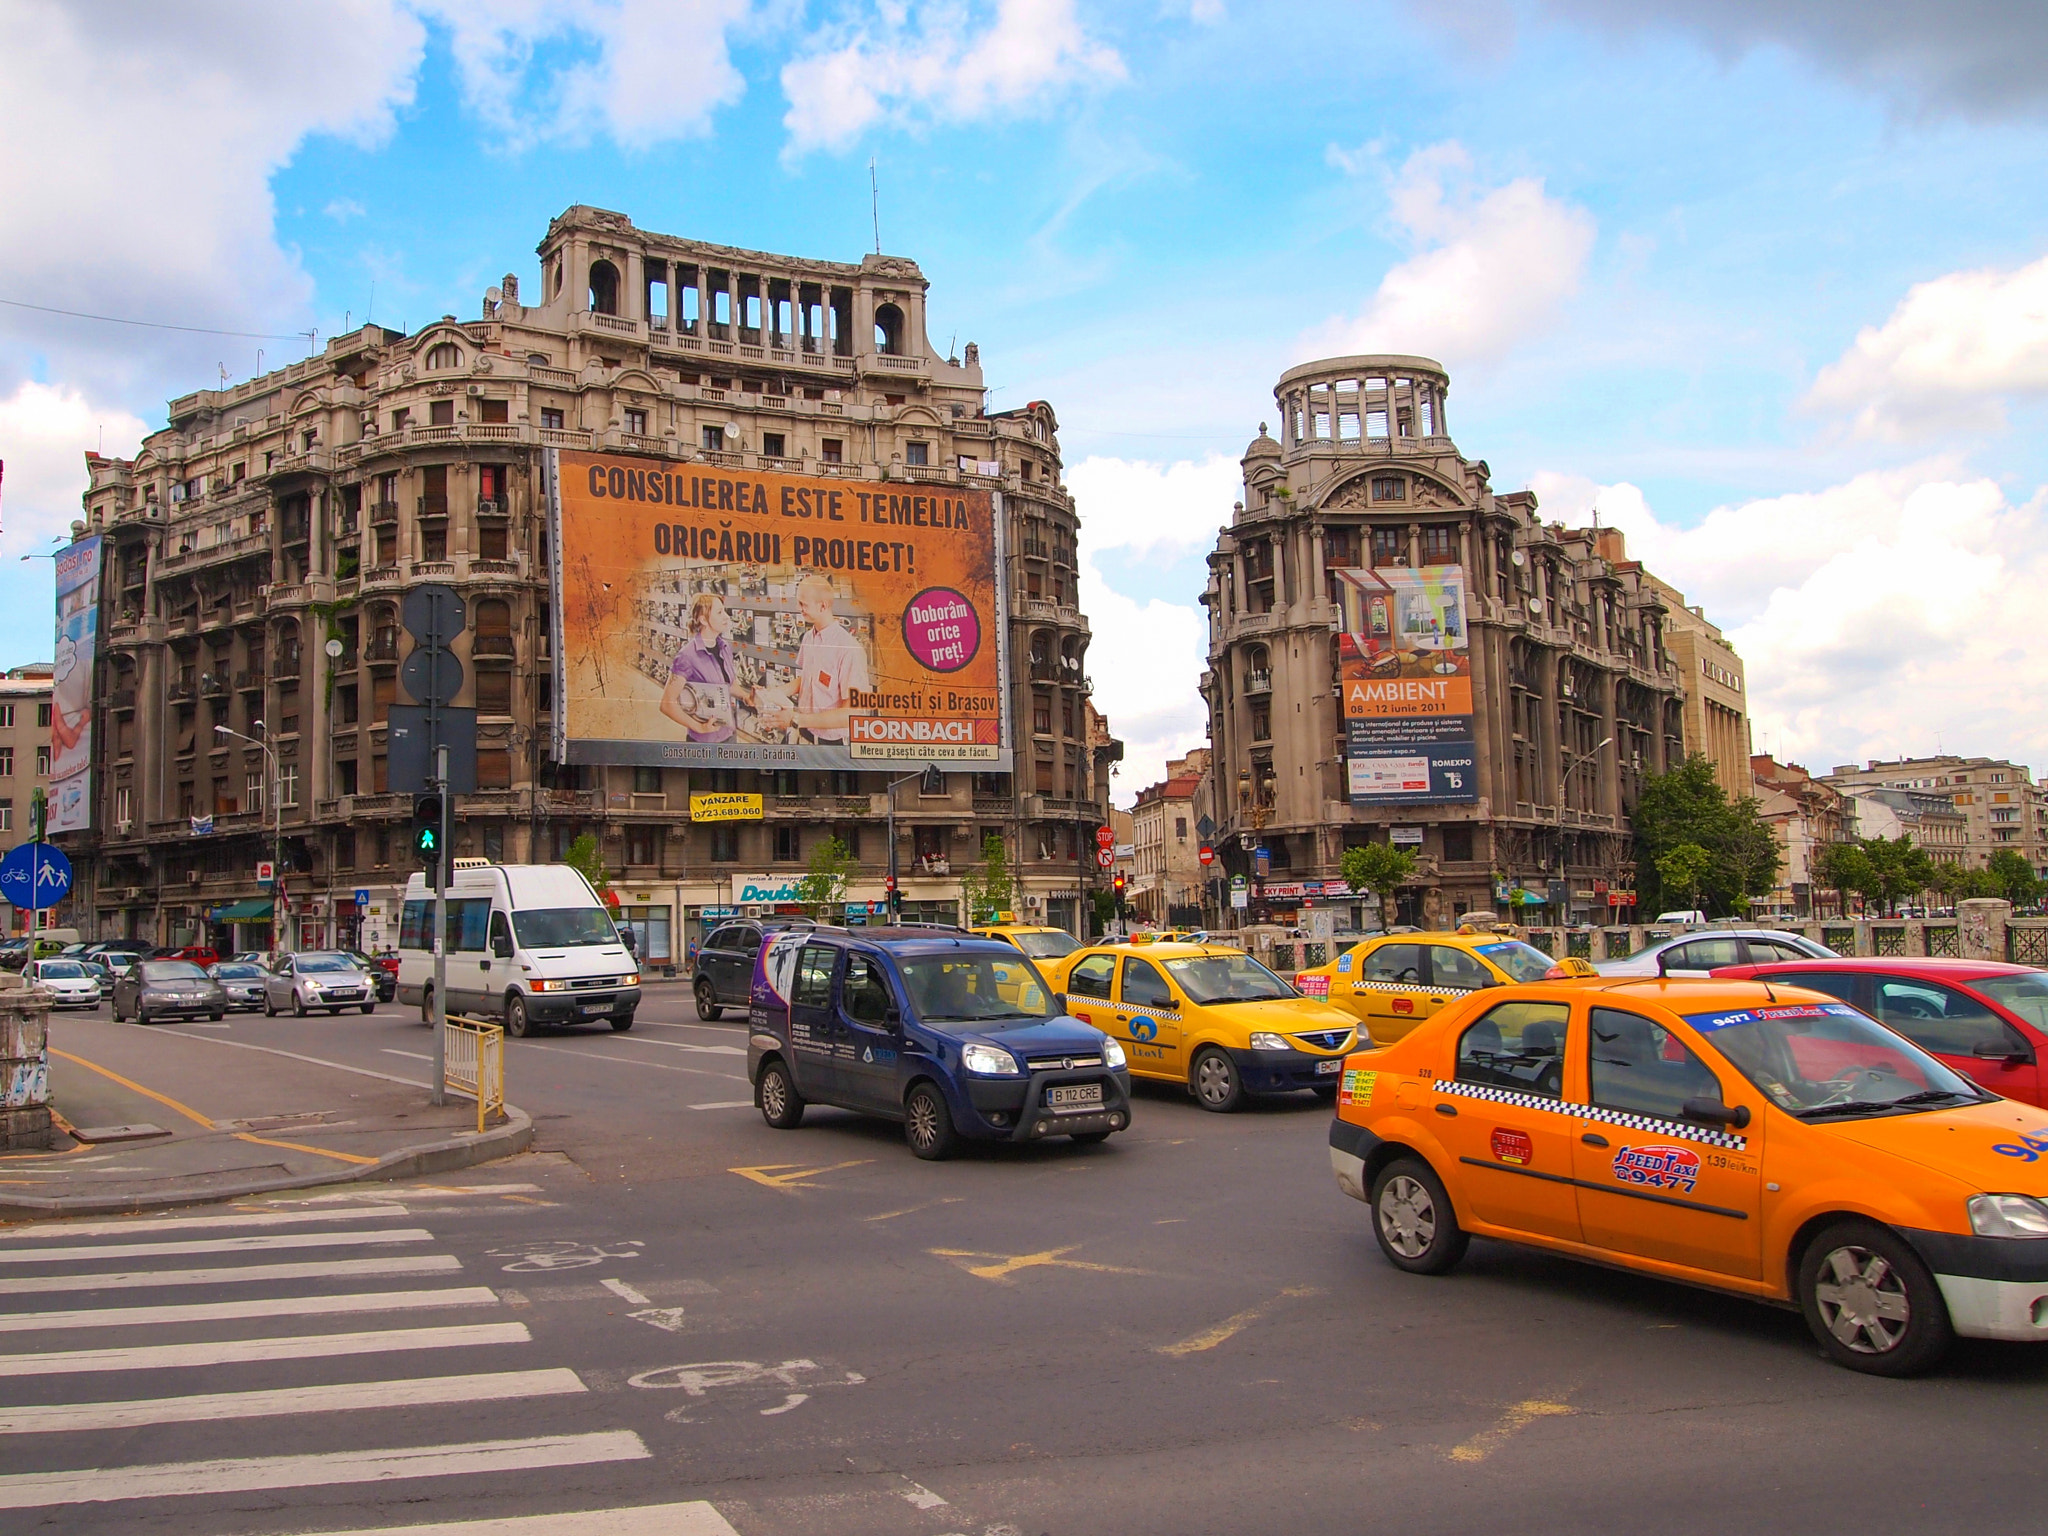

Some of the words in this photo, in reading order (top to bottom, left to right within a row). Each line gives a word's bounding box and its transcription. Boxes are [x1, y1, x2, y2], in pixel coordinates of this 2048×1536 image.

[589, 465, 768, 514] CONSILIEREA
[781, 486, 844, 521] ESTE
[856, 492, 969, 530] TEMELIA
[655, 520, 780, 564] ORICĂRUI
[794, 536, 914, 574] PROIECT!
[911, 601, 967, 625] Doborâm
[927, 623, 960, 642] orice
[932, 641, 964, 666] preț!
[1350, 681, 1448, 702] AMBIENT
[850, 689, 922, 714] București
[929, 691, 942, 715] și
[948, 692, 995, 716] Brașov
[1351, 705, 1363, 713] 08
[1376, 705, 1388, 713] 12
[1391, 704, 1417, 713] iunie
[1421, 703, 1446, 712] 2011
[853, 719, 973, 741] HORNBACH
[1352, 728, 1370, 736] pentru
[860, 745, 884, 755] Mereu
[887, 746, 916, 759] găsești
[918, 746, 935, 757] câte
[938, 748, 955, 757] ceva
[958, 747, 967, 757] de
[969, 747, 991, 757] făcut.
[1432, 759, 1472, 767] ROMEXPO
[700, 796, 749, 805] VANZARE
[694, 808, 761, 819] 0723.689.060
[1097, 832, 1113, 841] STOP
[1279, 887, 1300, 895] PRINT
[1568, 959, 1590, 973] TAXI
[1713, 1013, 1750, 1027] 9477
[1322, 1063, 1326, 1072] B
[1330, 1062, 1337, 1071] 07
[1055, 1090, 1062, 1101] B
[1066, 1089, 1077, 1100] 112
[1080, 1088, 1099, 1099] CRE
[1707, 1154, 1726, 1168] 1,39
[1727, 1161, 1758, 1175] lei/km
[1631, 1170, 1696, 1193] 9477
